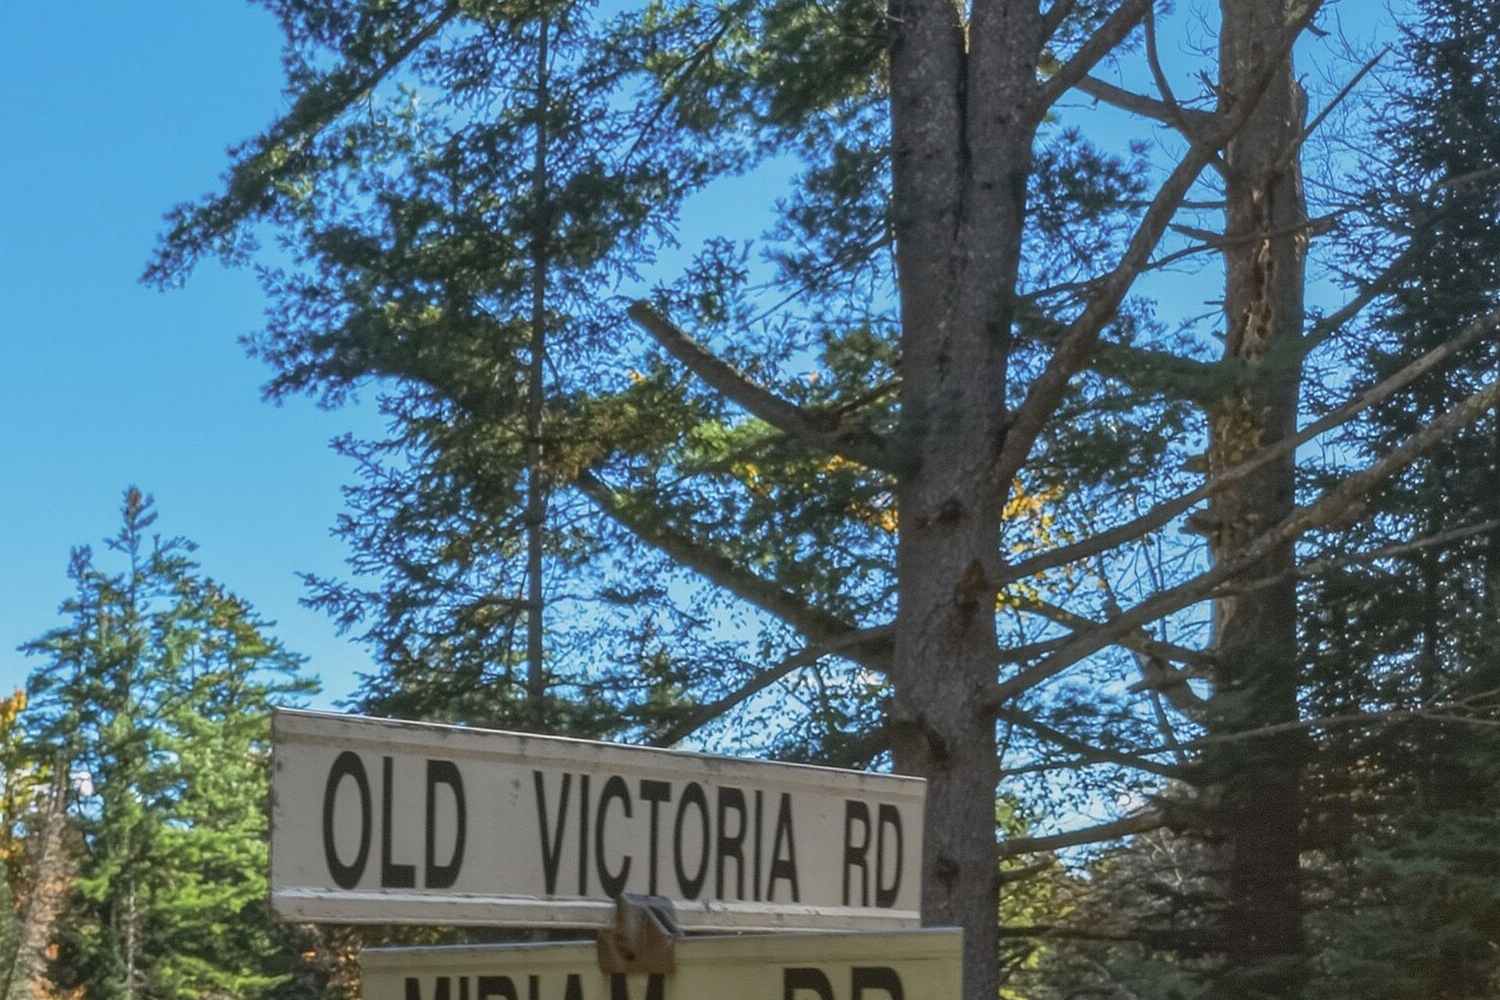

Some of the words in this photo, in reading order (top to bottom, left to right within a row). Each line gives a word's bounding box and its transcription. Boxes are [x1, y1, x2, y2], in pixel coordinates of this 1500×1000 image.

[323, 750, 467, 891] OLD
[534, 770, 800, 902] VICTORIA
[843, 800, 901, 908] RD
